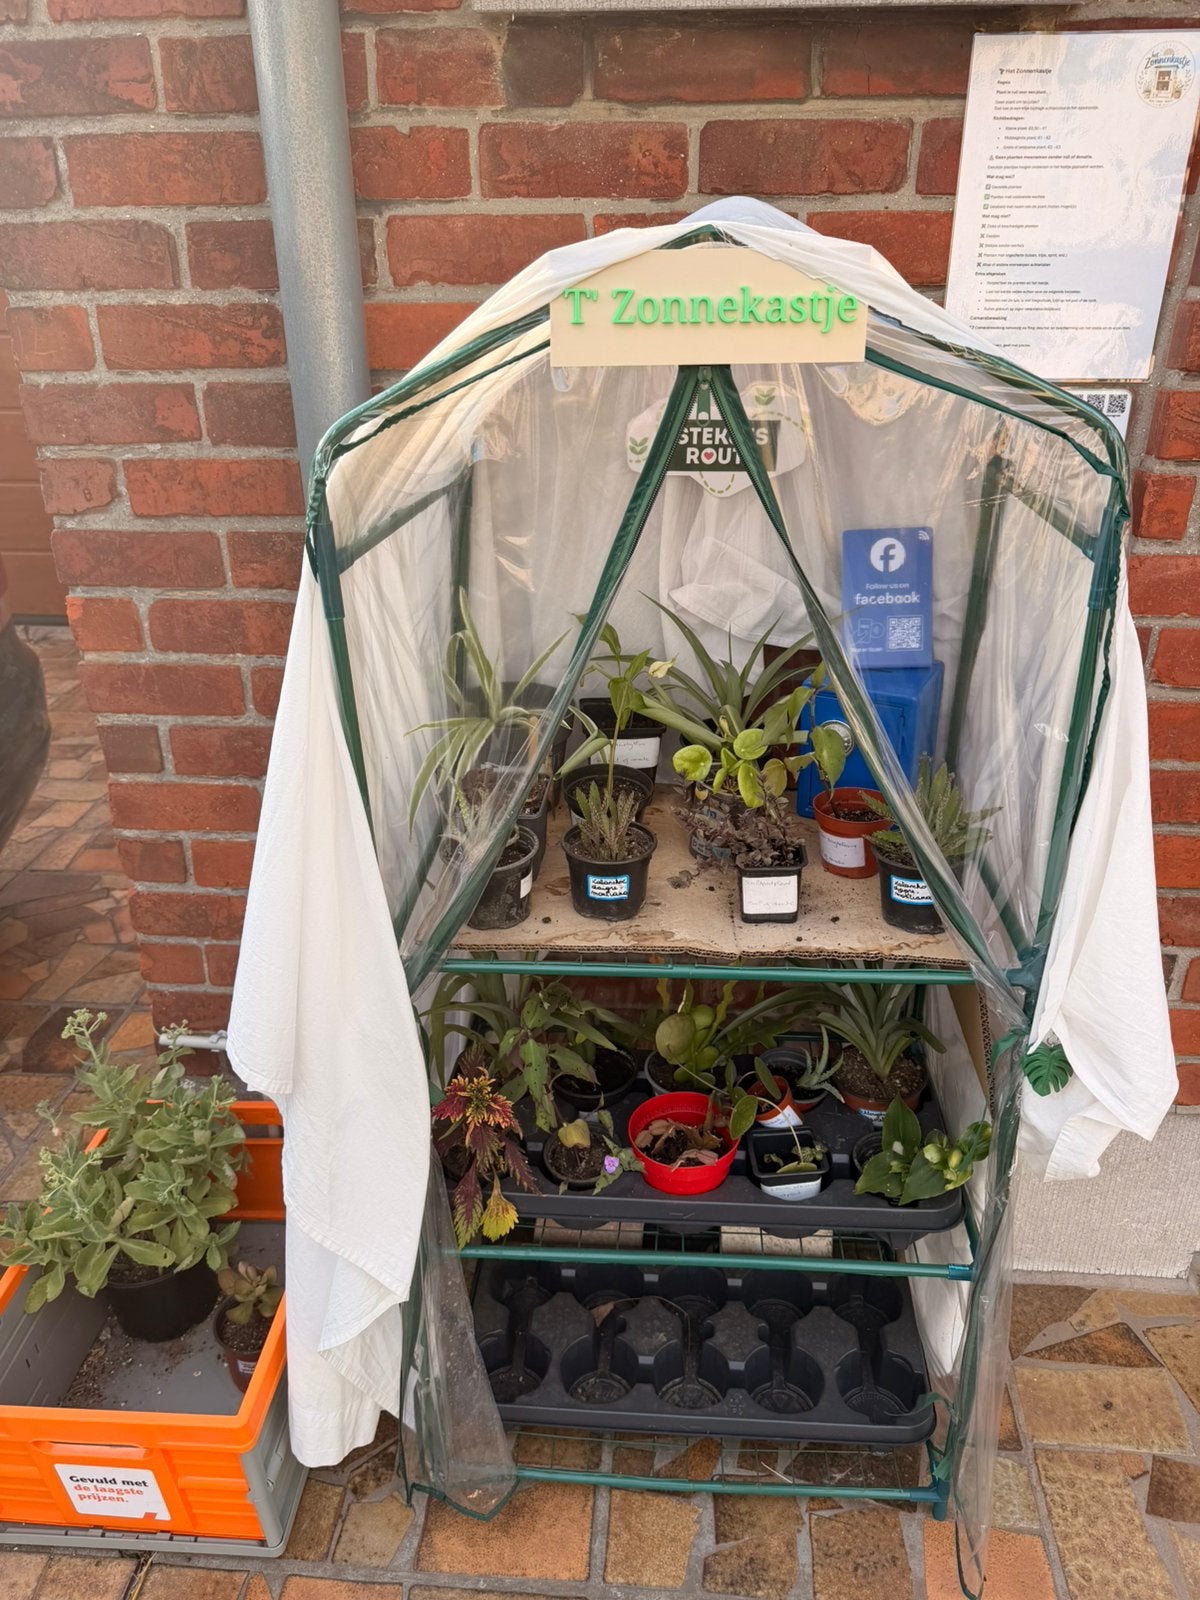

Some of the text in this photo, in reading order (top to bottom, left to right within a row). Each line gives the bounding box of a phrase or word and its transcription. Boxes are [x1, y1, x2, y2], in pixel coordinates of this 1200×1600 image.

[564, 285, 859, 334] T' Zonnekastje
[678, 427, 768, 445] STEKS
[855, 591, 920, 605] facebook
[69, 1476, 149, 1488] Gevuld met
[74, 1484, 144, 1496] de laagste
[78, 1494, 129, 1503] prijzen.
